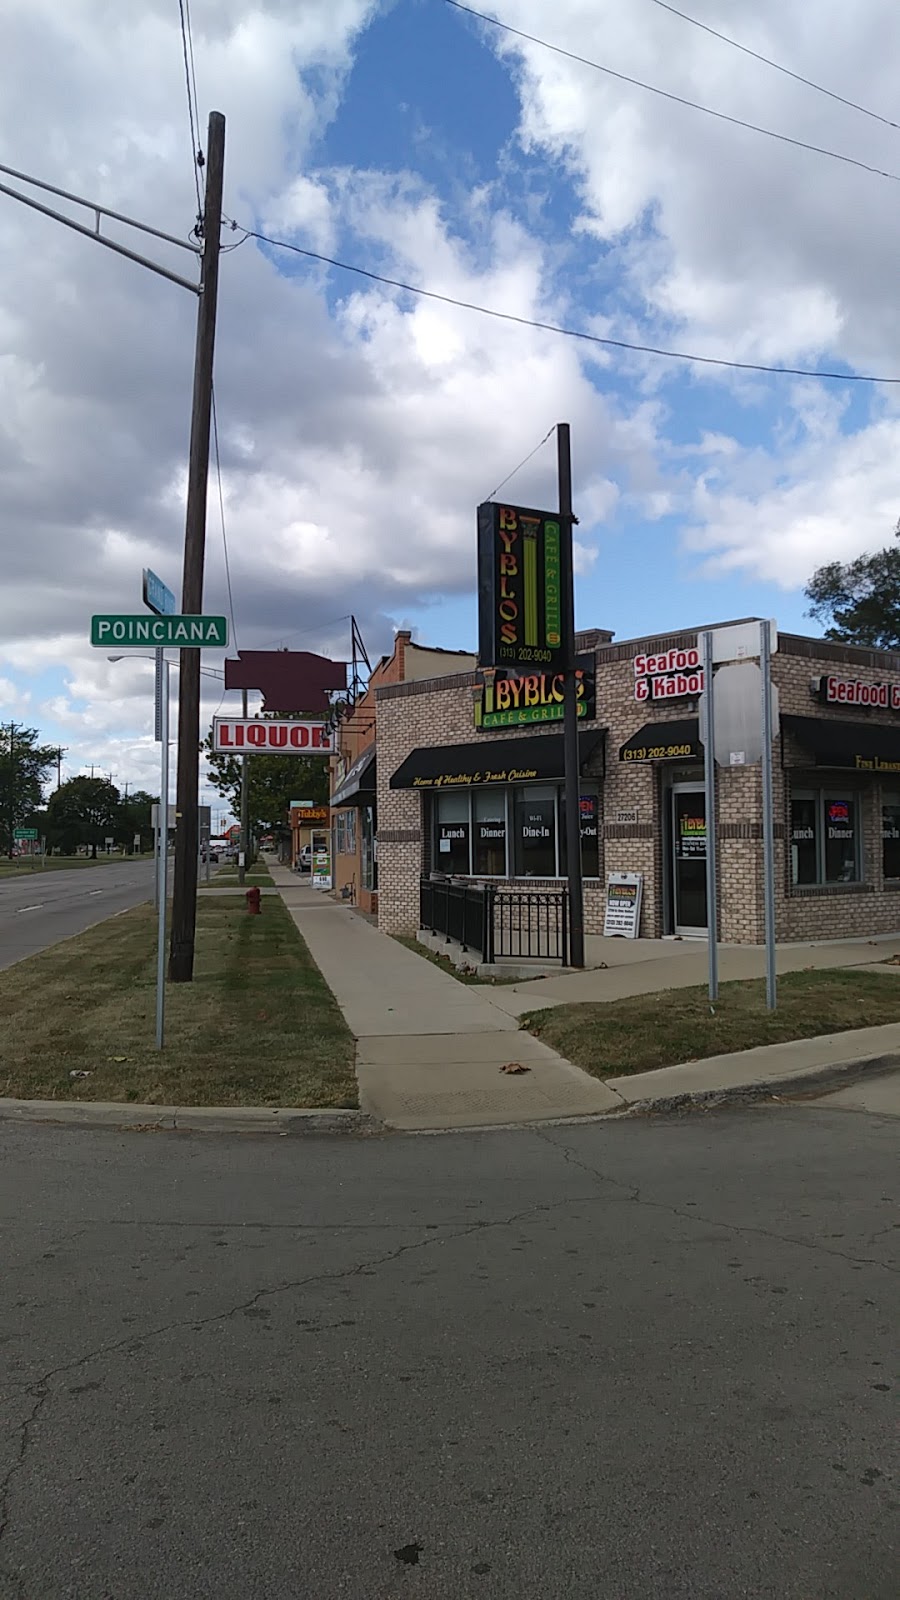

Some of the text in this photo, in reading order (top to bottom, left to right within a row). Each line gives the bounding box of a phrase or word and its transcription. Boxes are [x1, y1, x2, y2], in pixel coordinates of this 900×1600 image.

[499, 508, 518, 645] BYBLOS
[98, 621, 220, 640] POINCIANA
[500, 648, 552, 663] (313) 202-9040
[634, 650, 699, 676] Seafoo
[636, 681, 647, 700] &
[828, 677, 887, 705] Seafood
[518, 711, 527, 721] &
[531, 706, 565, 720] GRIL
[219, 724, 331, 748] LIQUOR
[623, 745, 691, 761] (313) 202-9040
[413, 769, 537, 786] Home of Healthy & Fresh Cuisine
[441, 828, 465, 838] Lunch
[480, 827, 506, 838] Dinner
[522, 826, 550, 838] Dine-In
[792, 827, 814, 840] unch
[828, 827, 853, 839] Dinner
